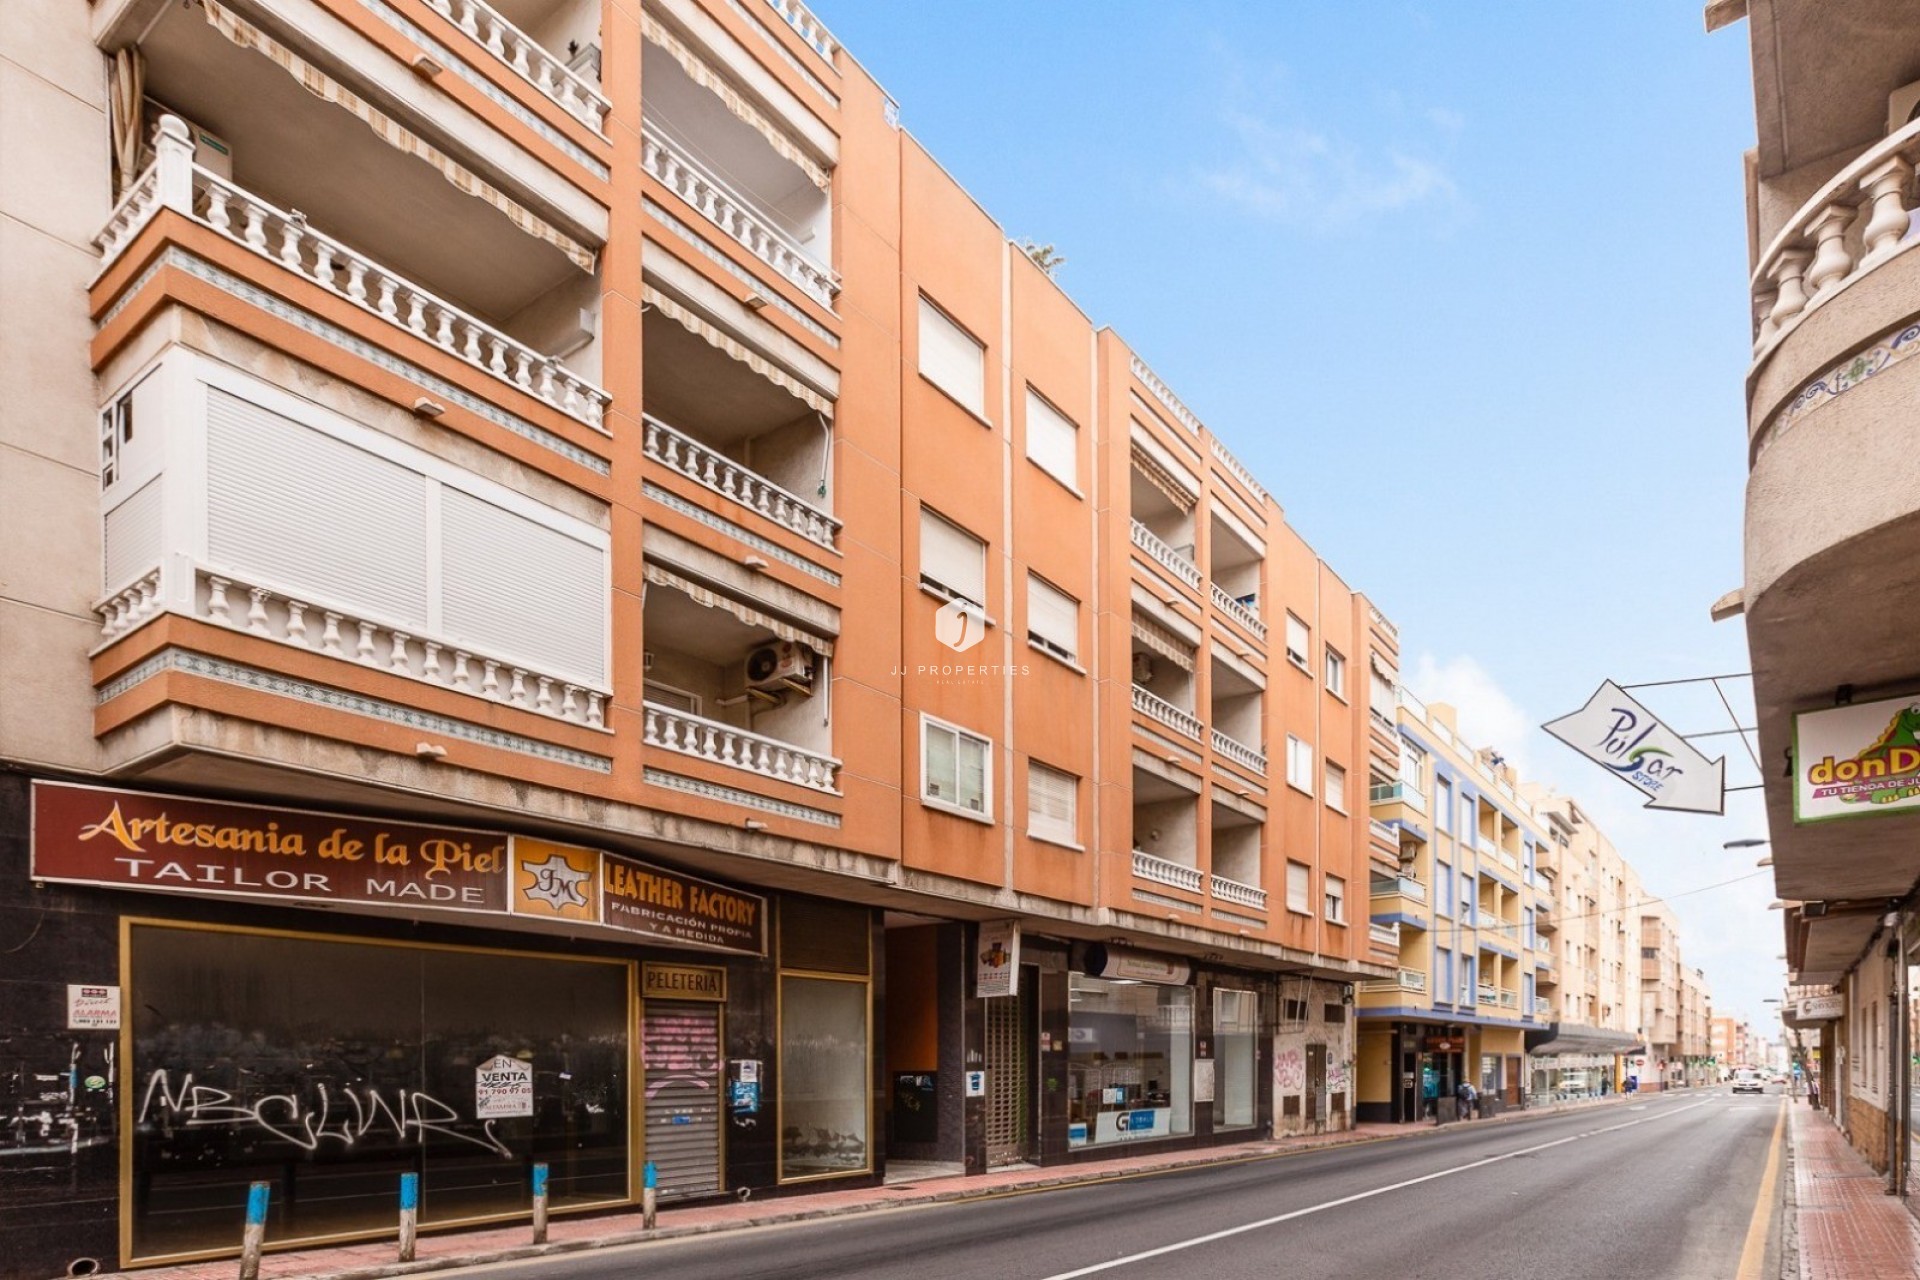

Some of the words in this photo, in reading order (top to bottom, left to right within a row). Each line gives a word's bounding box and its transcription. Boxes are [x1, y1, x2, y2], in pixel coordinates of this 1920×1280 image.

[1632, 771, 1664, 791] STORE
[1840, 783, 1884, 793] TIENDA
[1888, 780, 1905, 788] DE
[78, 799, 306, 856] Artesania
[318, 828, 364, 861] de
[375, 833, 410, 866] la
[420, 838, 505, 881] Piel
[114, 857, 332, 892] TAILOR
[366, 878, 485, 904] MADE
[605, 862, 683, 910] LEATHER
[690, 886, 756, 926] FACTORY
[611, 902, 707, 930] FABRICACIÓN
[710, 923, 753, 940] PROPIA
[649, 922, 658, 931] Y
[663, 925, 672, 934] A
[675, 926, 725, 945] MEDIDA
[647, 970, 717, 993] PELETERIA
[494, 1058, 512, 1069] EN
[482, 1072, 528, 1082] VENTA
